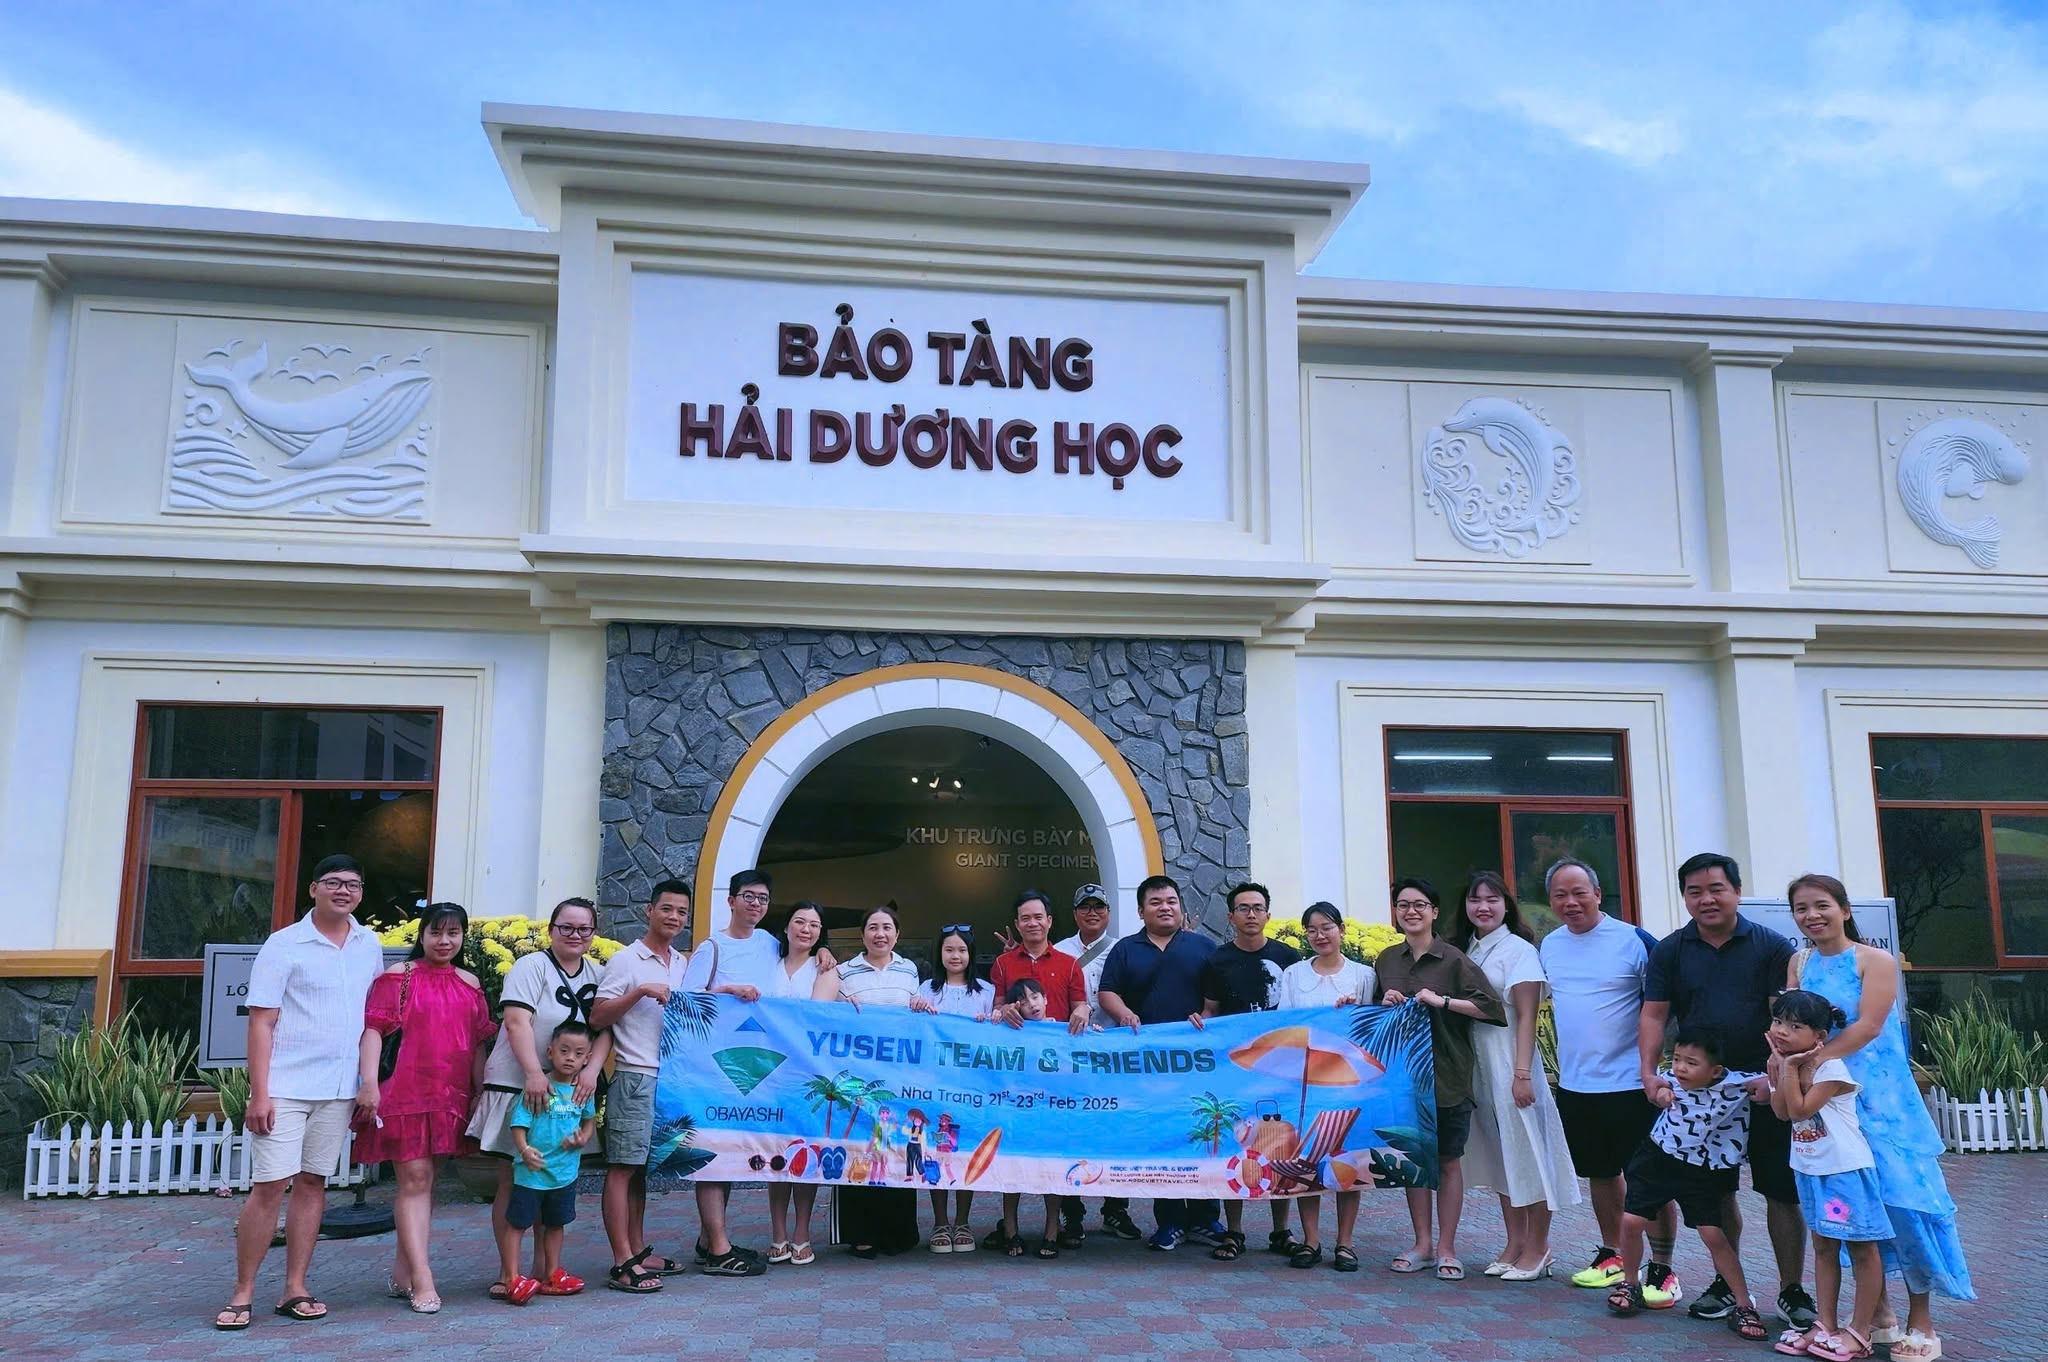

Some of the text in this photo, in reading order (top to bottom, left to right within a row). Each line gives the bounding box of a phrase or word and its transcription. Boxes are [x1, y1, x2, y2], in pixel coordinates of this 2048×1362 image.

[778, 302, 1094, 392] BẢO TÀNG
[679, 382, 1184, 490] HẢI DƯƠNG HỌC
[906, 827, 949, 845] KHU
[955, 825, 1027, 846] TRƯNG
[1032, 826, 1073, 846] BÀY
[955, 852, 1011, 868] GIANT
[226, 981, 249, 997] LỐ
[806, 1030, 1217, 1074] YUSEN TEAM & FRIENDS
[902, 1085, 934, 1102] Nha
[938, 1088, 983, 1109] Trang
[1049, 1095, 1077, 1111] Feb
[1082, 1096, 1118, 1111] 2025
[705, 1106, 784, 1122] OBAYASHI
